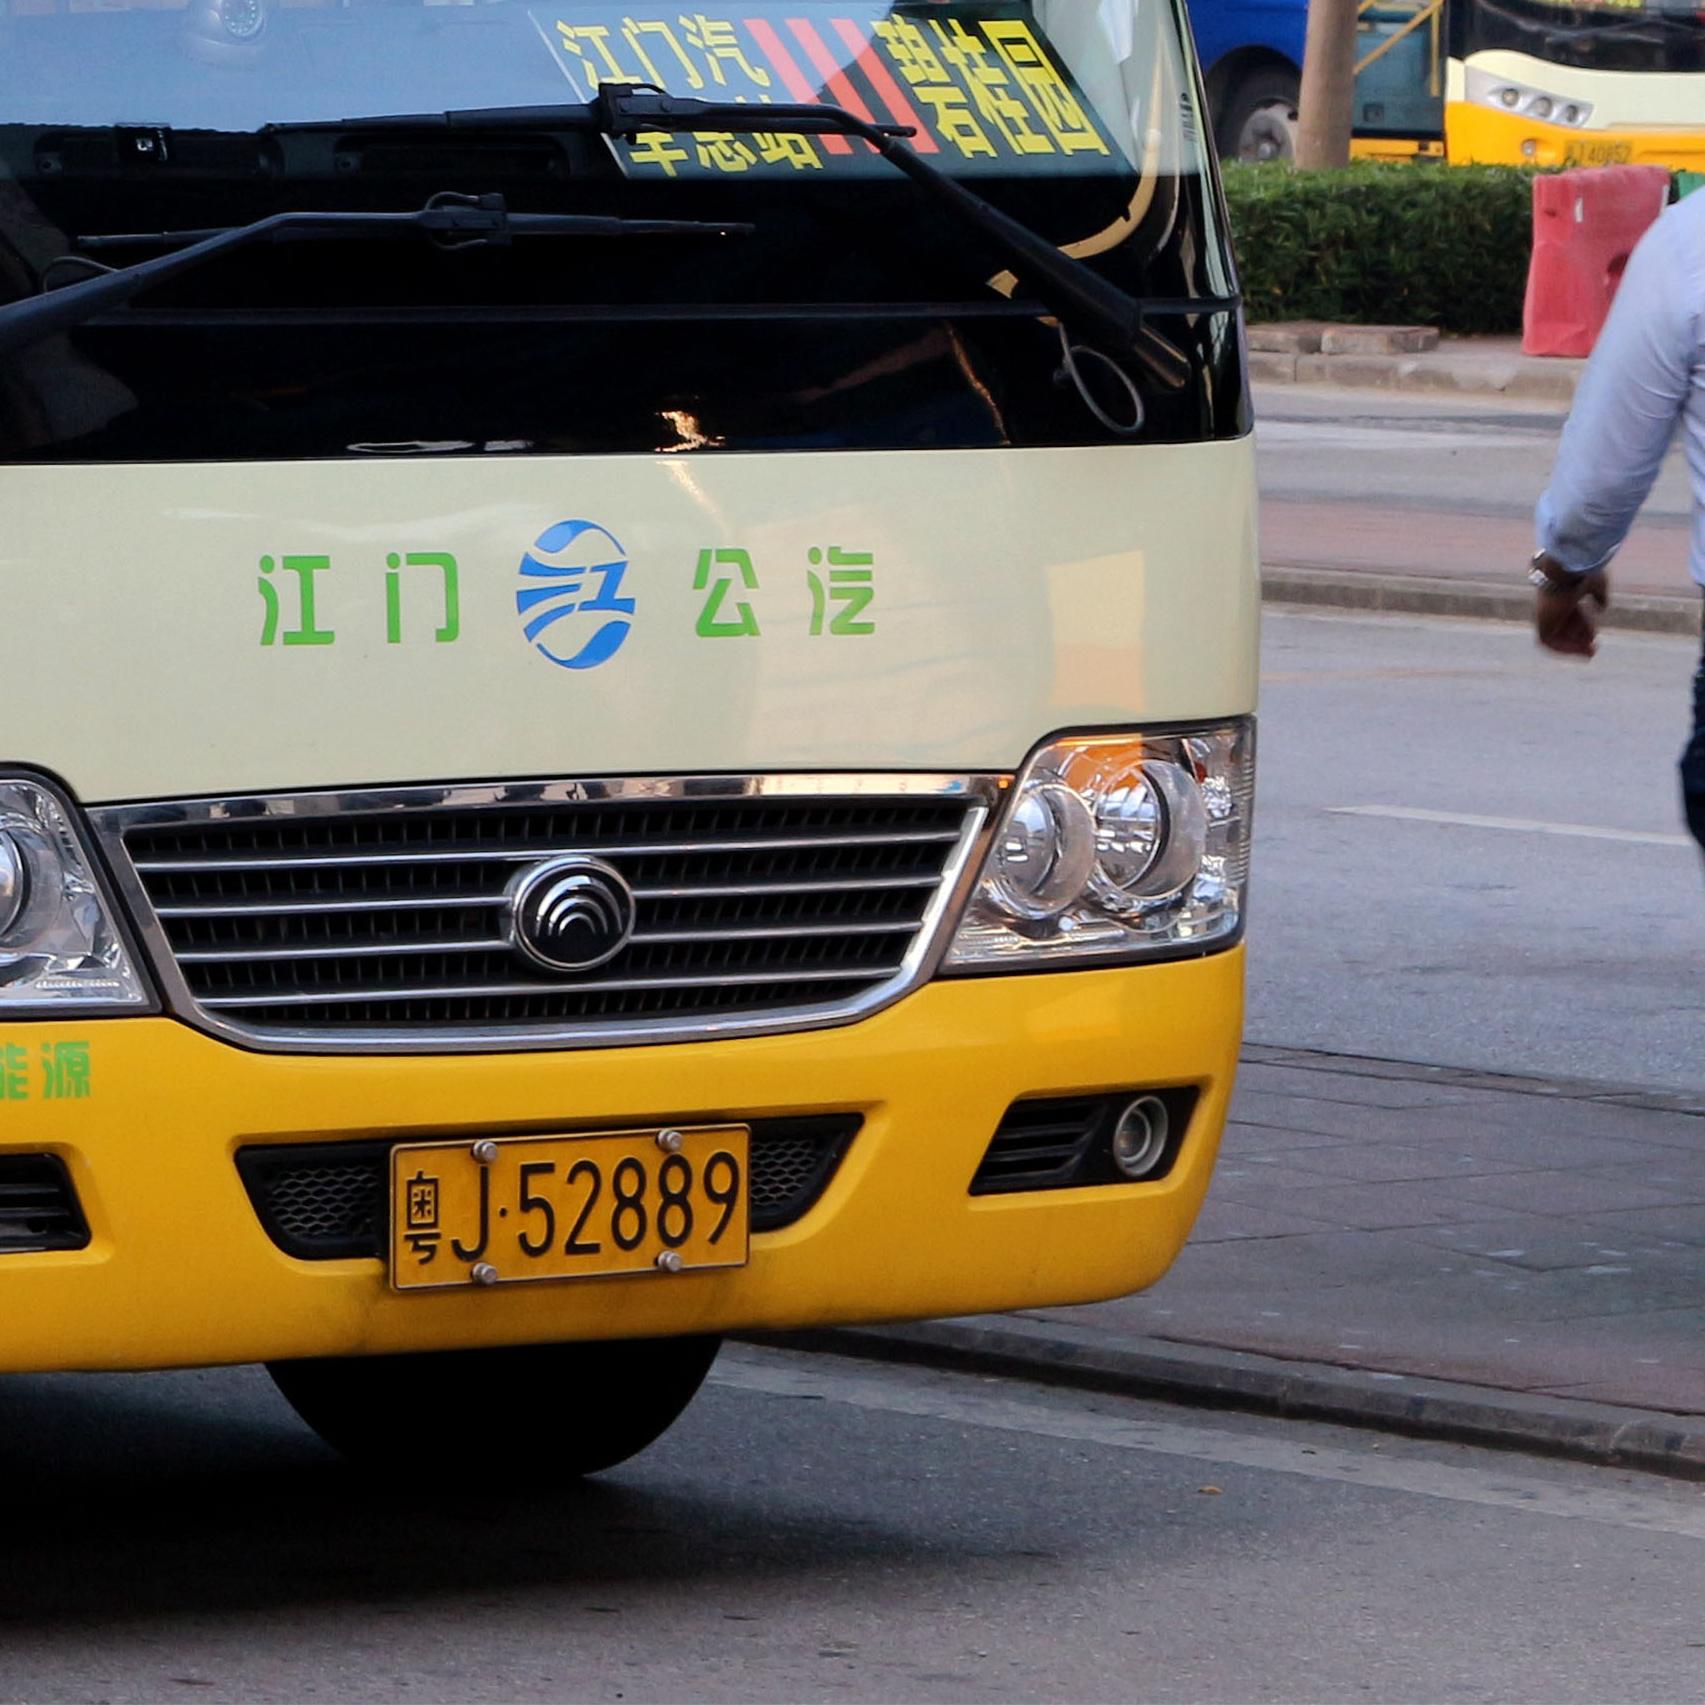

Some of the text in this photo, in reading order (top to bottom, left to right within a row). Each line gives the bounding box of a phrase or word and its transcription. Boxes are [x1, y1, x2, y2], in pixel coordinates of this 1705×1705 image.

[870, 12, 1112, 160] 碧桂园
[257, 545, 876, 646] 江门 公汽
